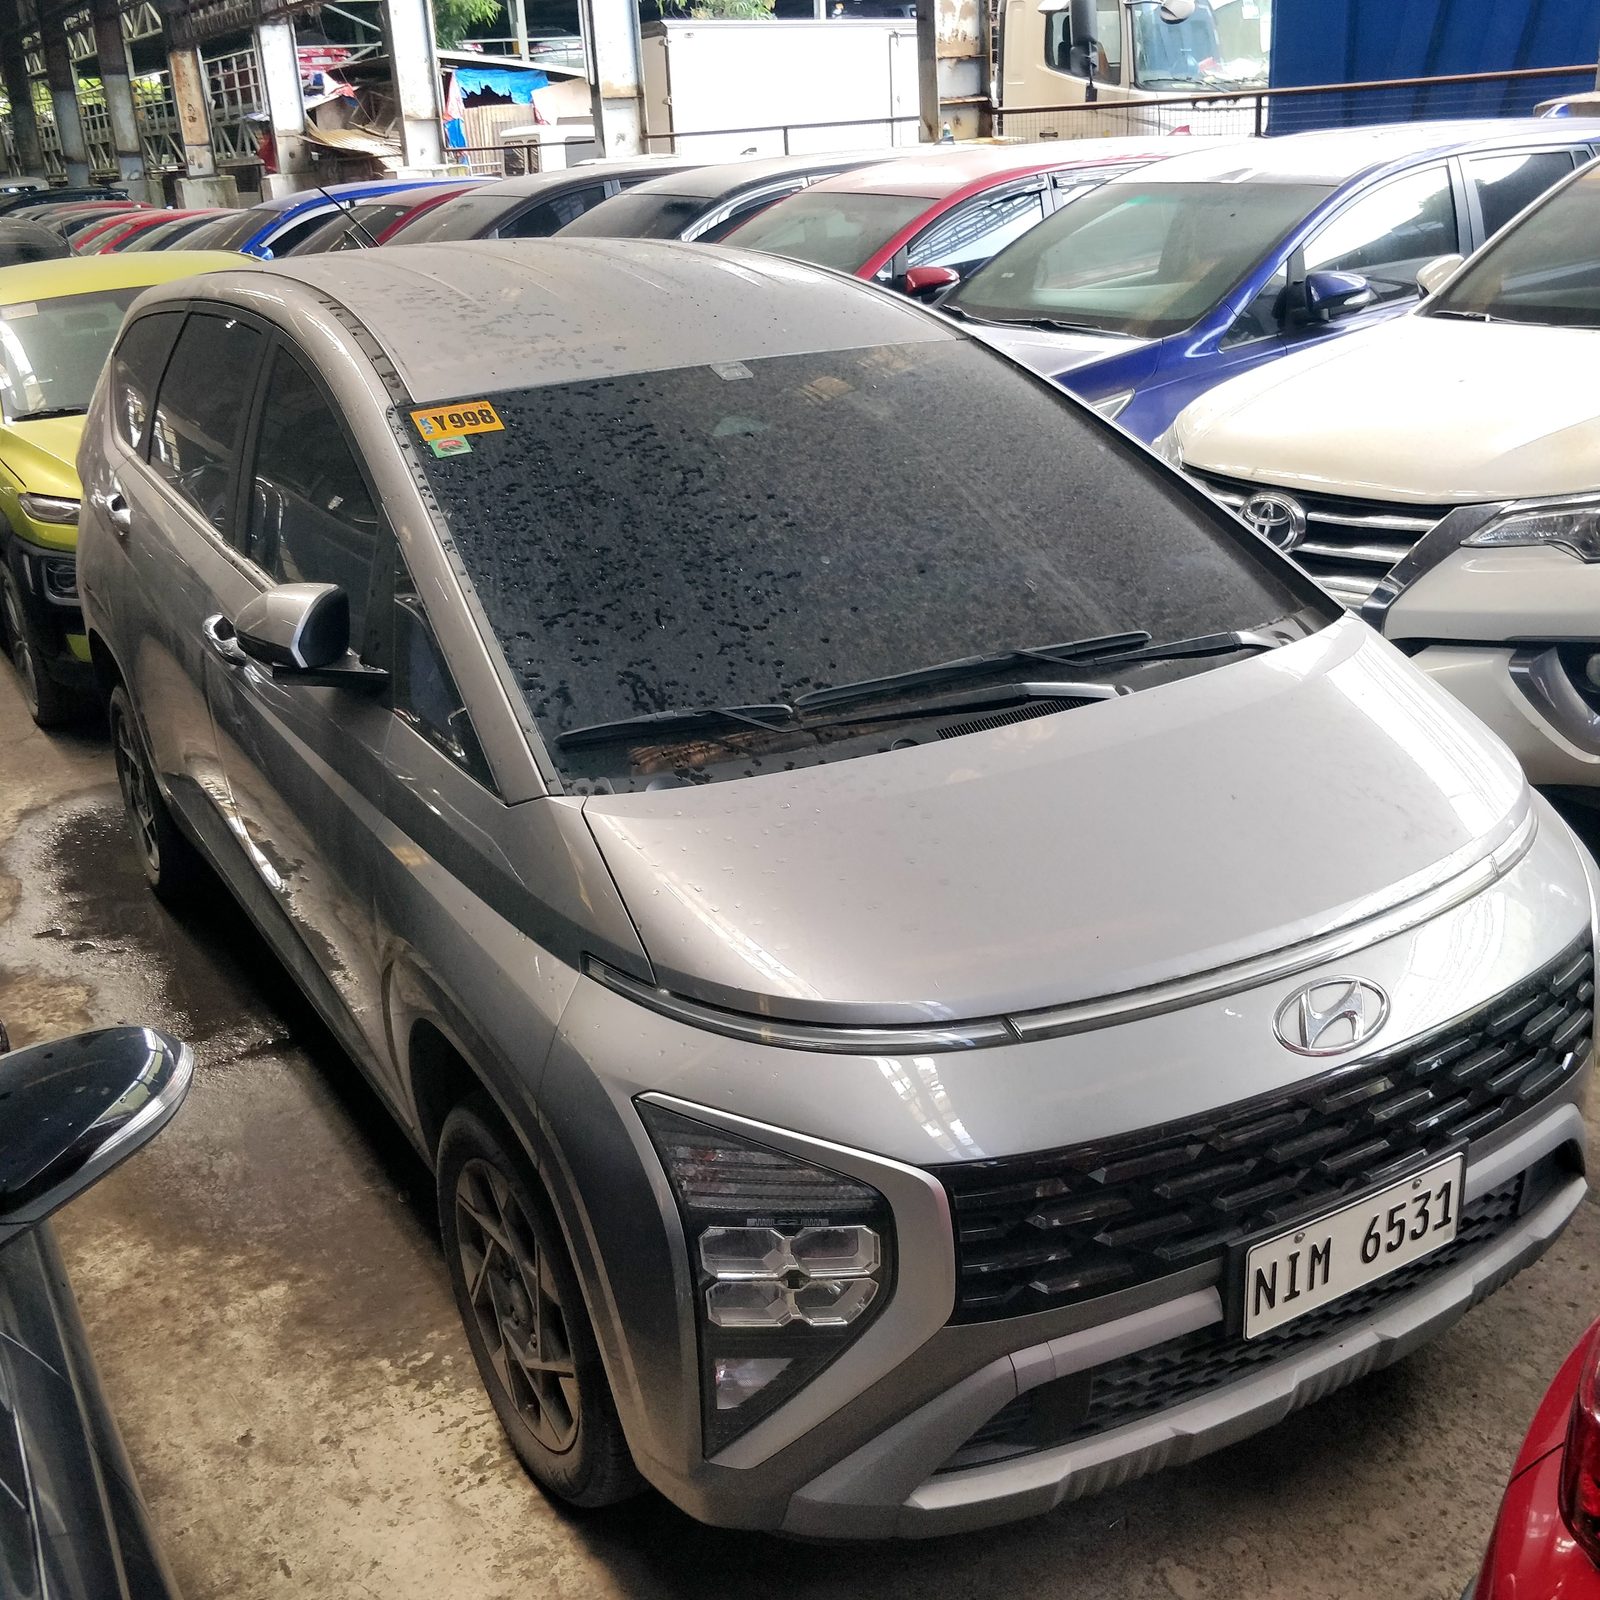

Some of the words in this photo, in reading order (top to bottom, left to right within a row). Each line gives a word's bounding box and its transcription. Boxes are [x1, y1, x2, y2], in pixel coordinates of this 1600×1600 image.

[432, 409, 495, 431] Y998
[1255, 1237, 1331, 1316] NIM
[1361, 1181, 1452, 1264] 6531
